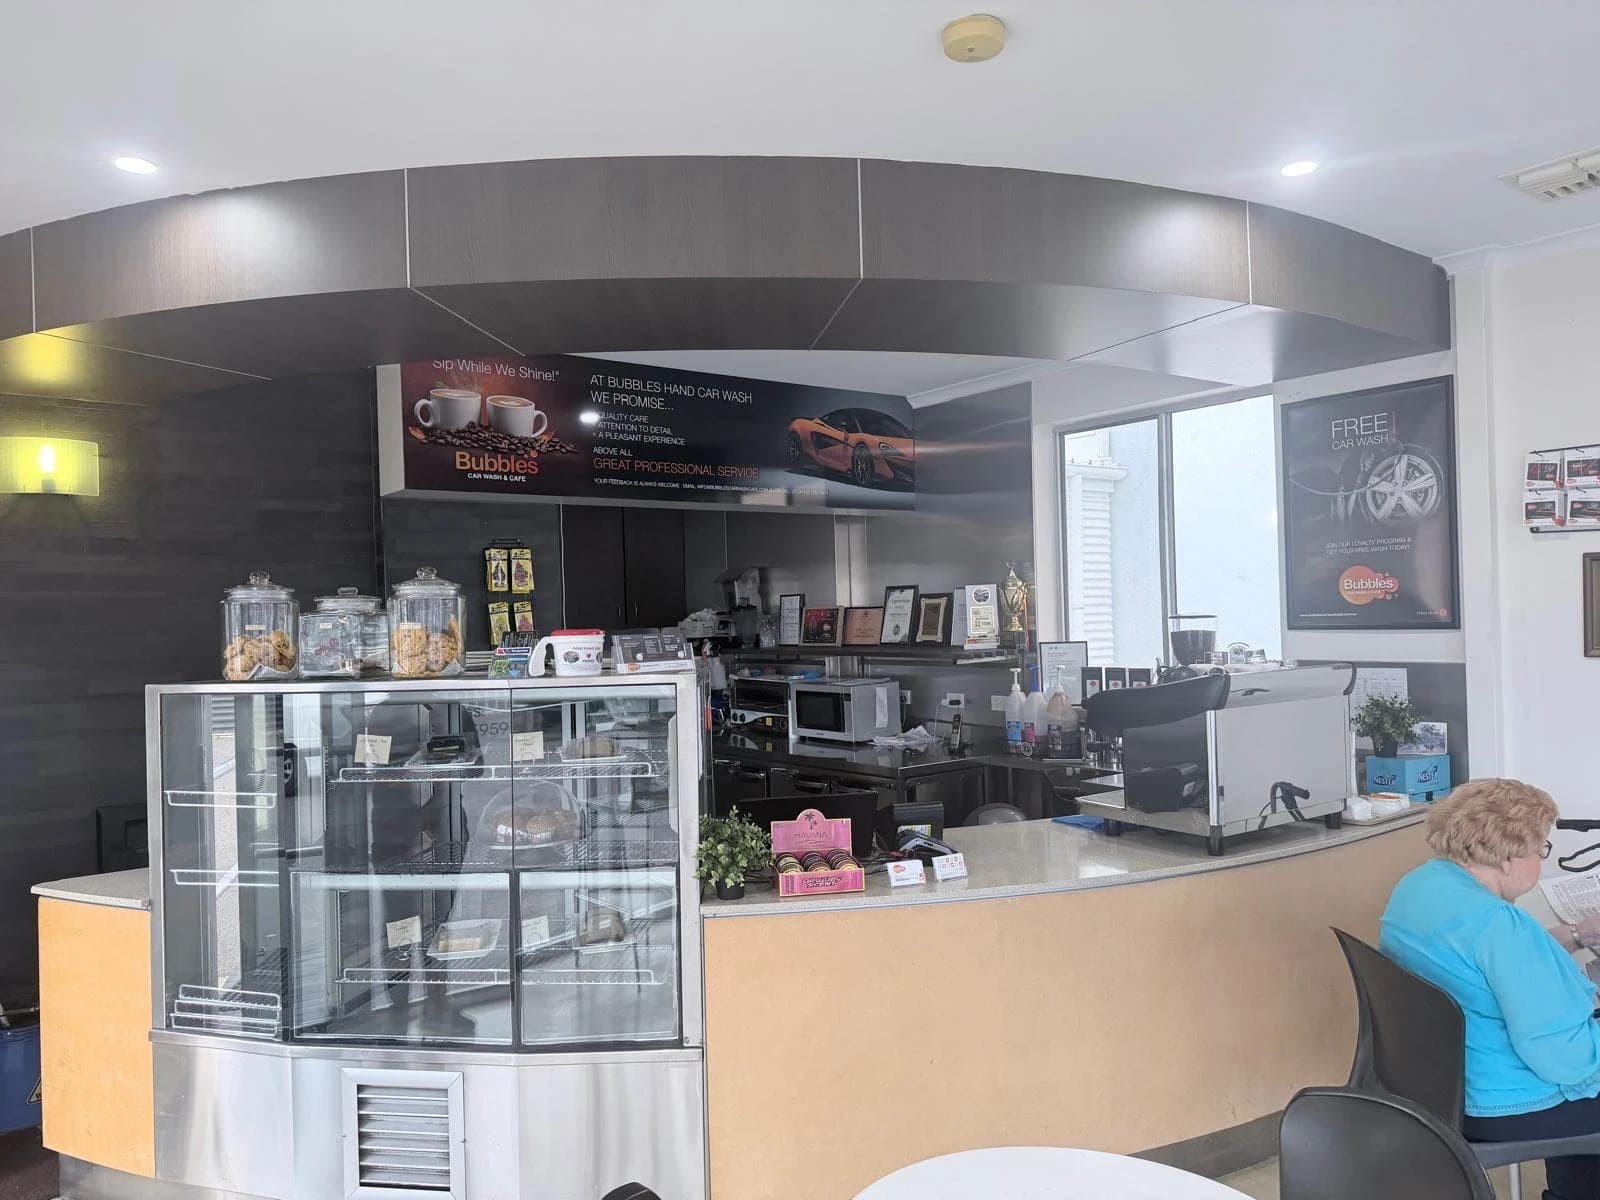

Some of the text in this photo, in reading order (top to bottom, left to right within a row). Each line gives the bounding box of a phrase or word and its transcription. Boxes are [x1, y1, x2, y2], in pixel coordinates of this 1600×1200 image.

[432, 359, 454, 372] Sip
[456, 359, 492, 374] While
[495, 364, 516, 377] We
[590, 374, 752, 404] AT BUBBLES HAND CAR WASH
[590, 390, 674, 411] WE PROMISE...
[599, 412, 649, 424] QUALITY CARE
[599, 421, 673, 435] ATTENTION TO DETAIL
[1331, 412, 1389, 440] FREE
[605, 432, 642, 442] PLEASANT
[643, 434, 686, 446] EXPERIENCE
[1331, 433, 1389, 450] CAR WASH
[592, 446, 633, 457] ABOVE ALL
[455, 451, 539, 474] Bubbles
[593, 457, 759, 479] GREAT PROFESSIONAL SERVICE
[483, 473, 502, 481] WASH
[608, 478, 633, 486] FEEDBACK
[1351, 538, 1375, 547] LOYALTY
[1343, 578, 1394, 590] Bubbles
[794, 831, 829, 840] HAVANA
